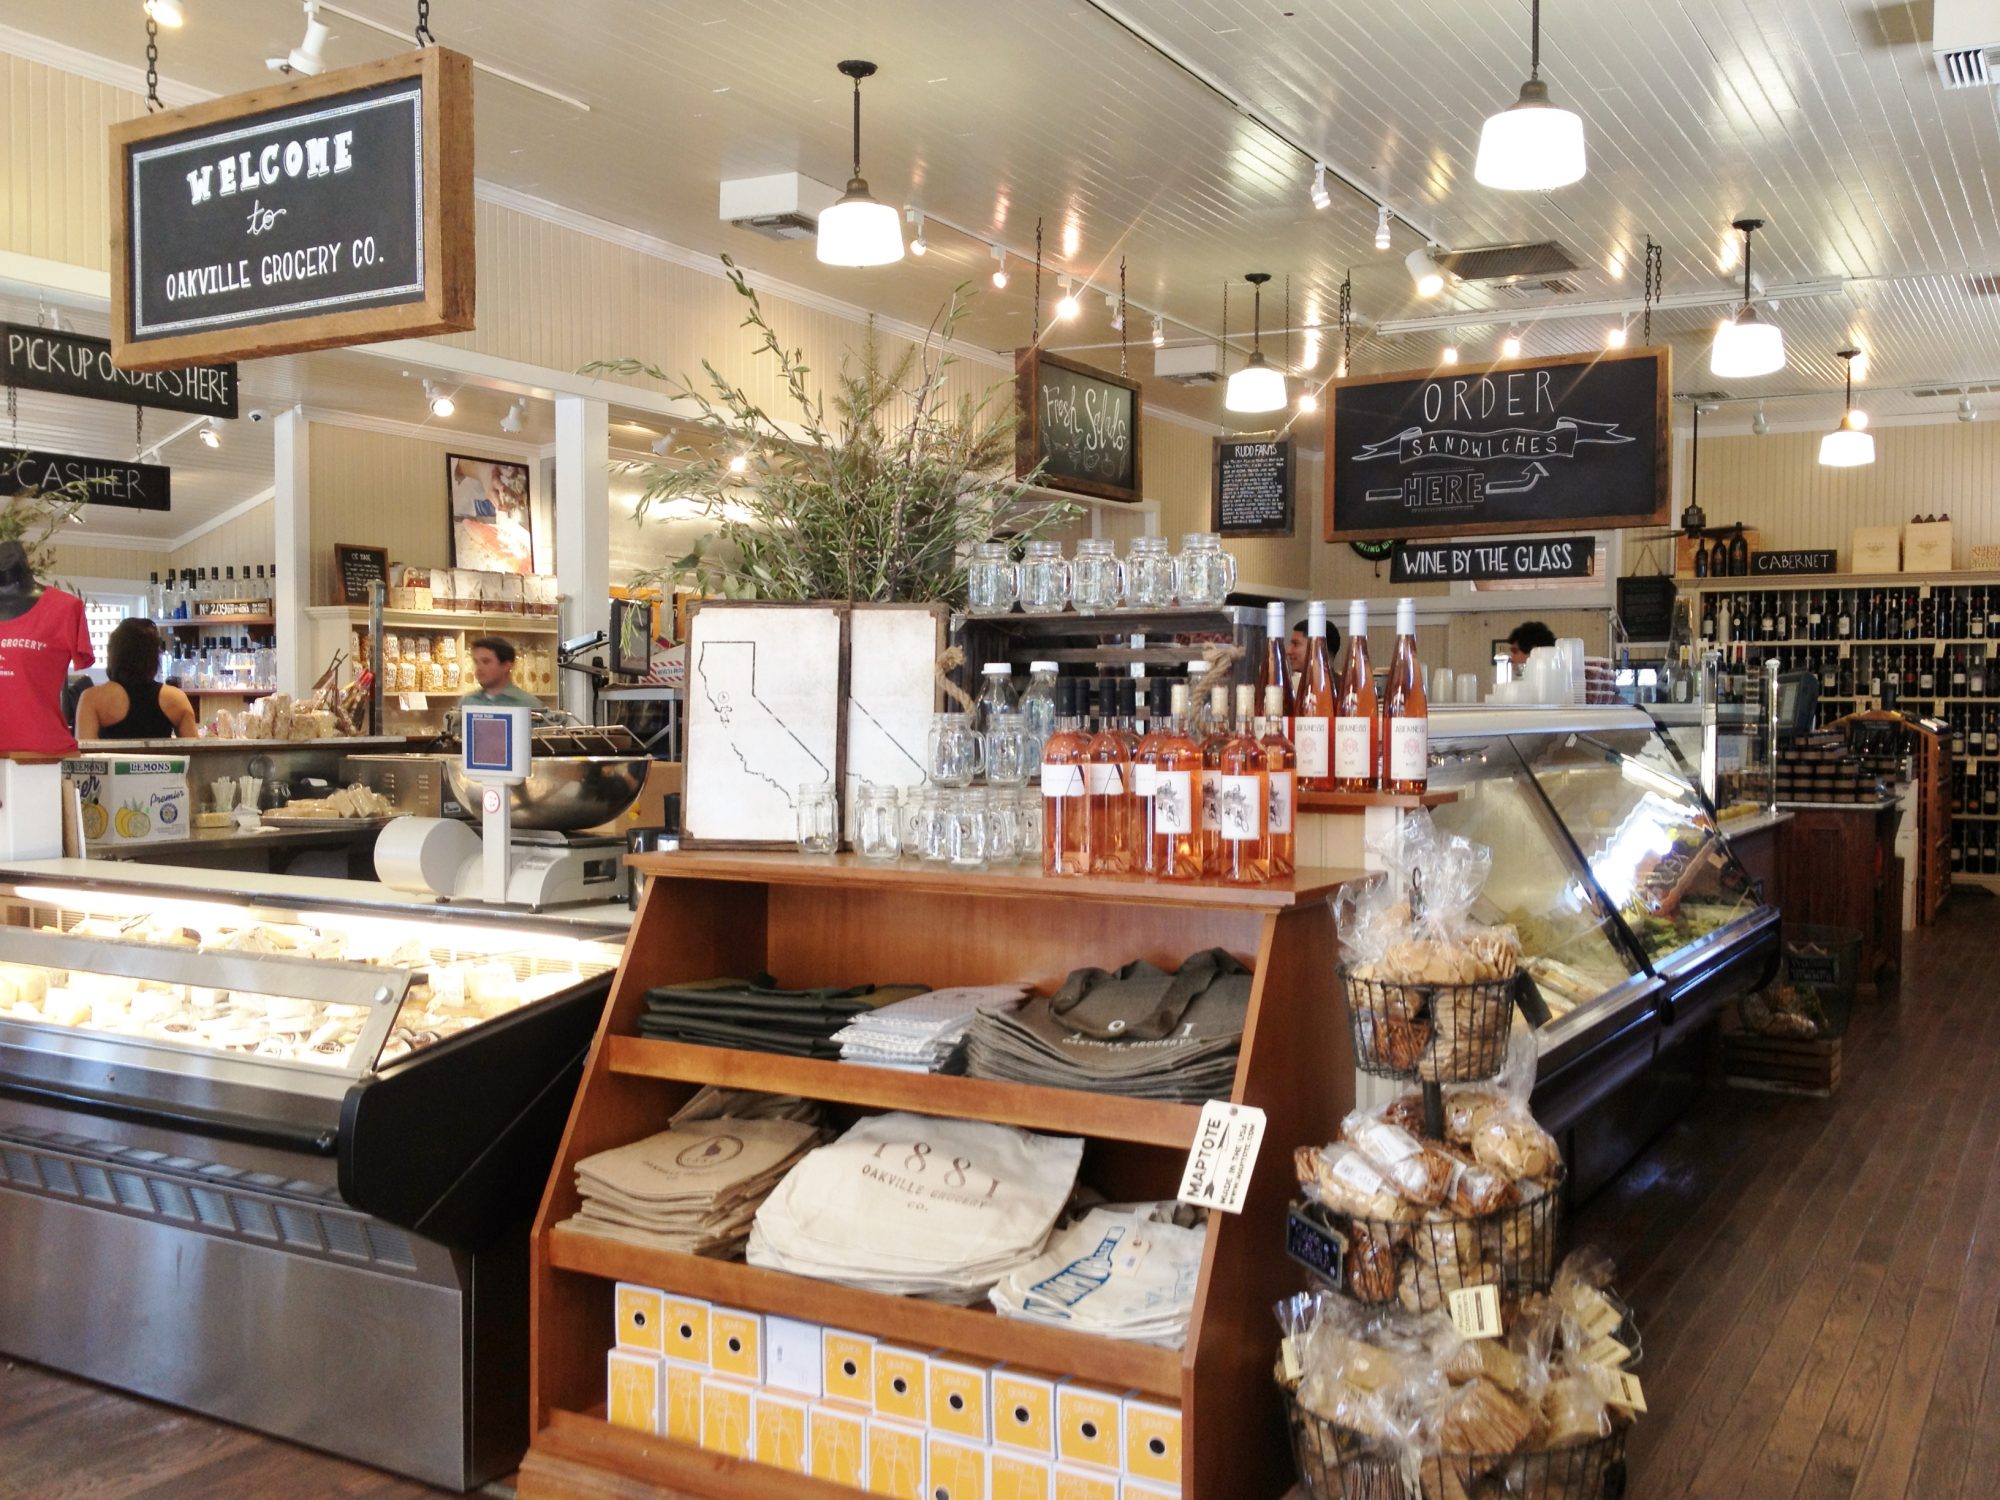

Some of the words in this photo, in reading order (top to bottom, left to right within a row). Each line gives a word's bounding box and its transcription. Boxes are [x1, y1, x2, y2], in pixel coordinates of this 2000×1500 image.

[186, 130, 353, 205] WELCOME
[246, 199, 287, 236] to
[165, 260, 251, 302] OAKVILLE
[260, 242, 342, 285] GROCERY
[352, 236, 385, 267] CO.
[8, 333, 66, 373] PICK
[68, 344, 94, 380] UP
[186, 366, 229, 405] HERE
[1423, 370, 1555, 423] ORDER
[1042, 384, 1084, 435] Fresh
[1085, 388, 1127, 452] Salads
[1411, 435, 1558, 458] SANDWICHES
[16, 459, 147, 500] CASHIER
[1404, 473, 1485, 507] HERE
[1402, 551, 1447, 575] WINE
[1453, 549, 1475, 573] BY
[1475, 547, 1509, 572] THE
[1514, 543, 1573, 571] GLASS
[1758, 554, 1831, 570] CABERNET
[130, 762, 170, 772] LEMONS
[150, 789, 184, 807] Premier
[1186, 1117, 1222, 1198] MAPTOTE
[862, 1164, 925, 1196] OAKVILLE
